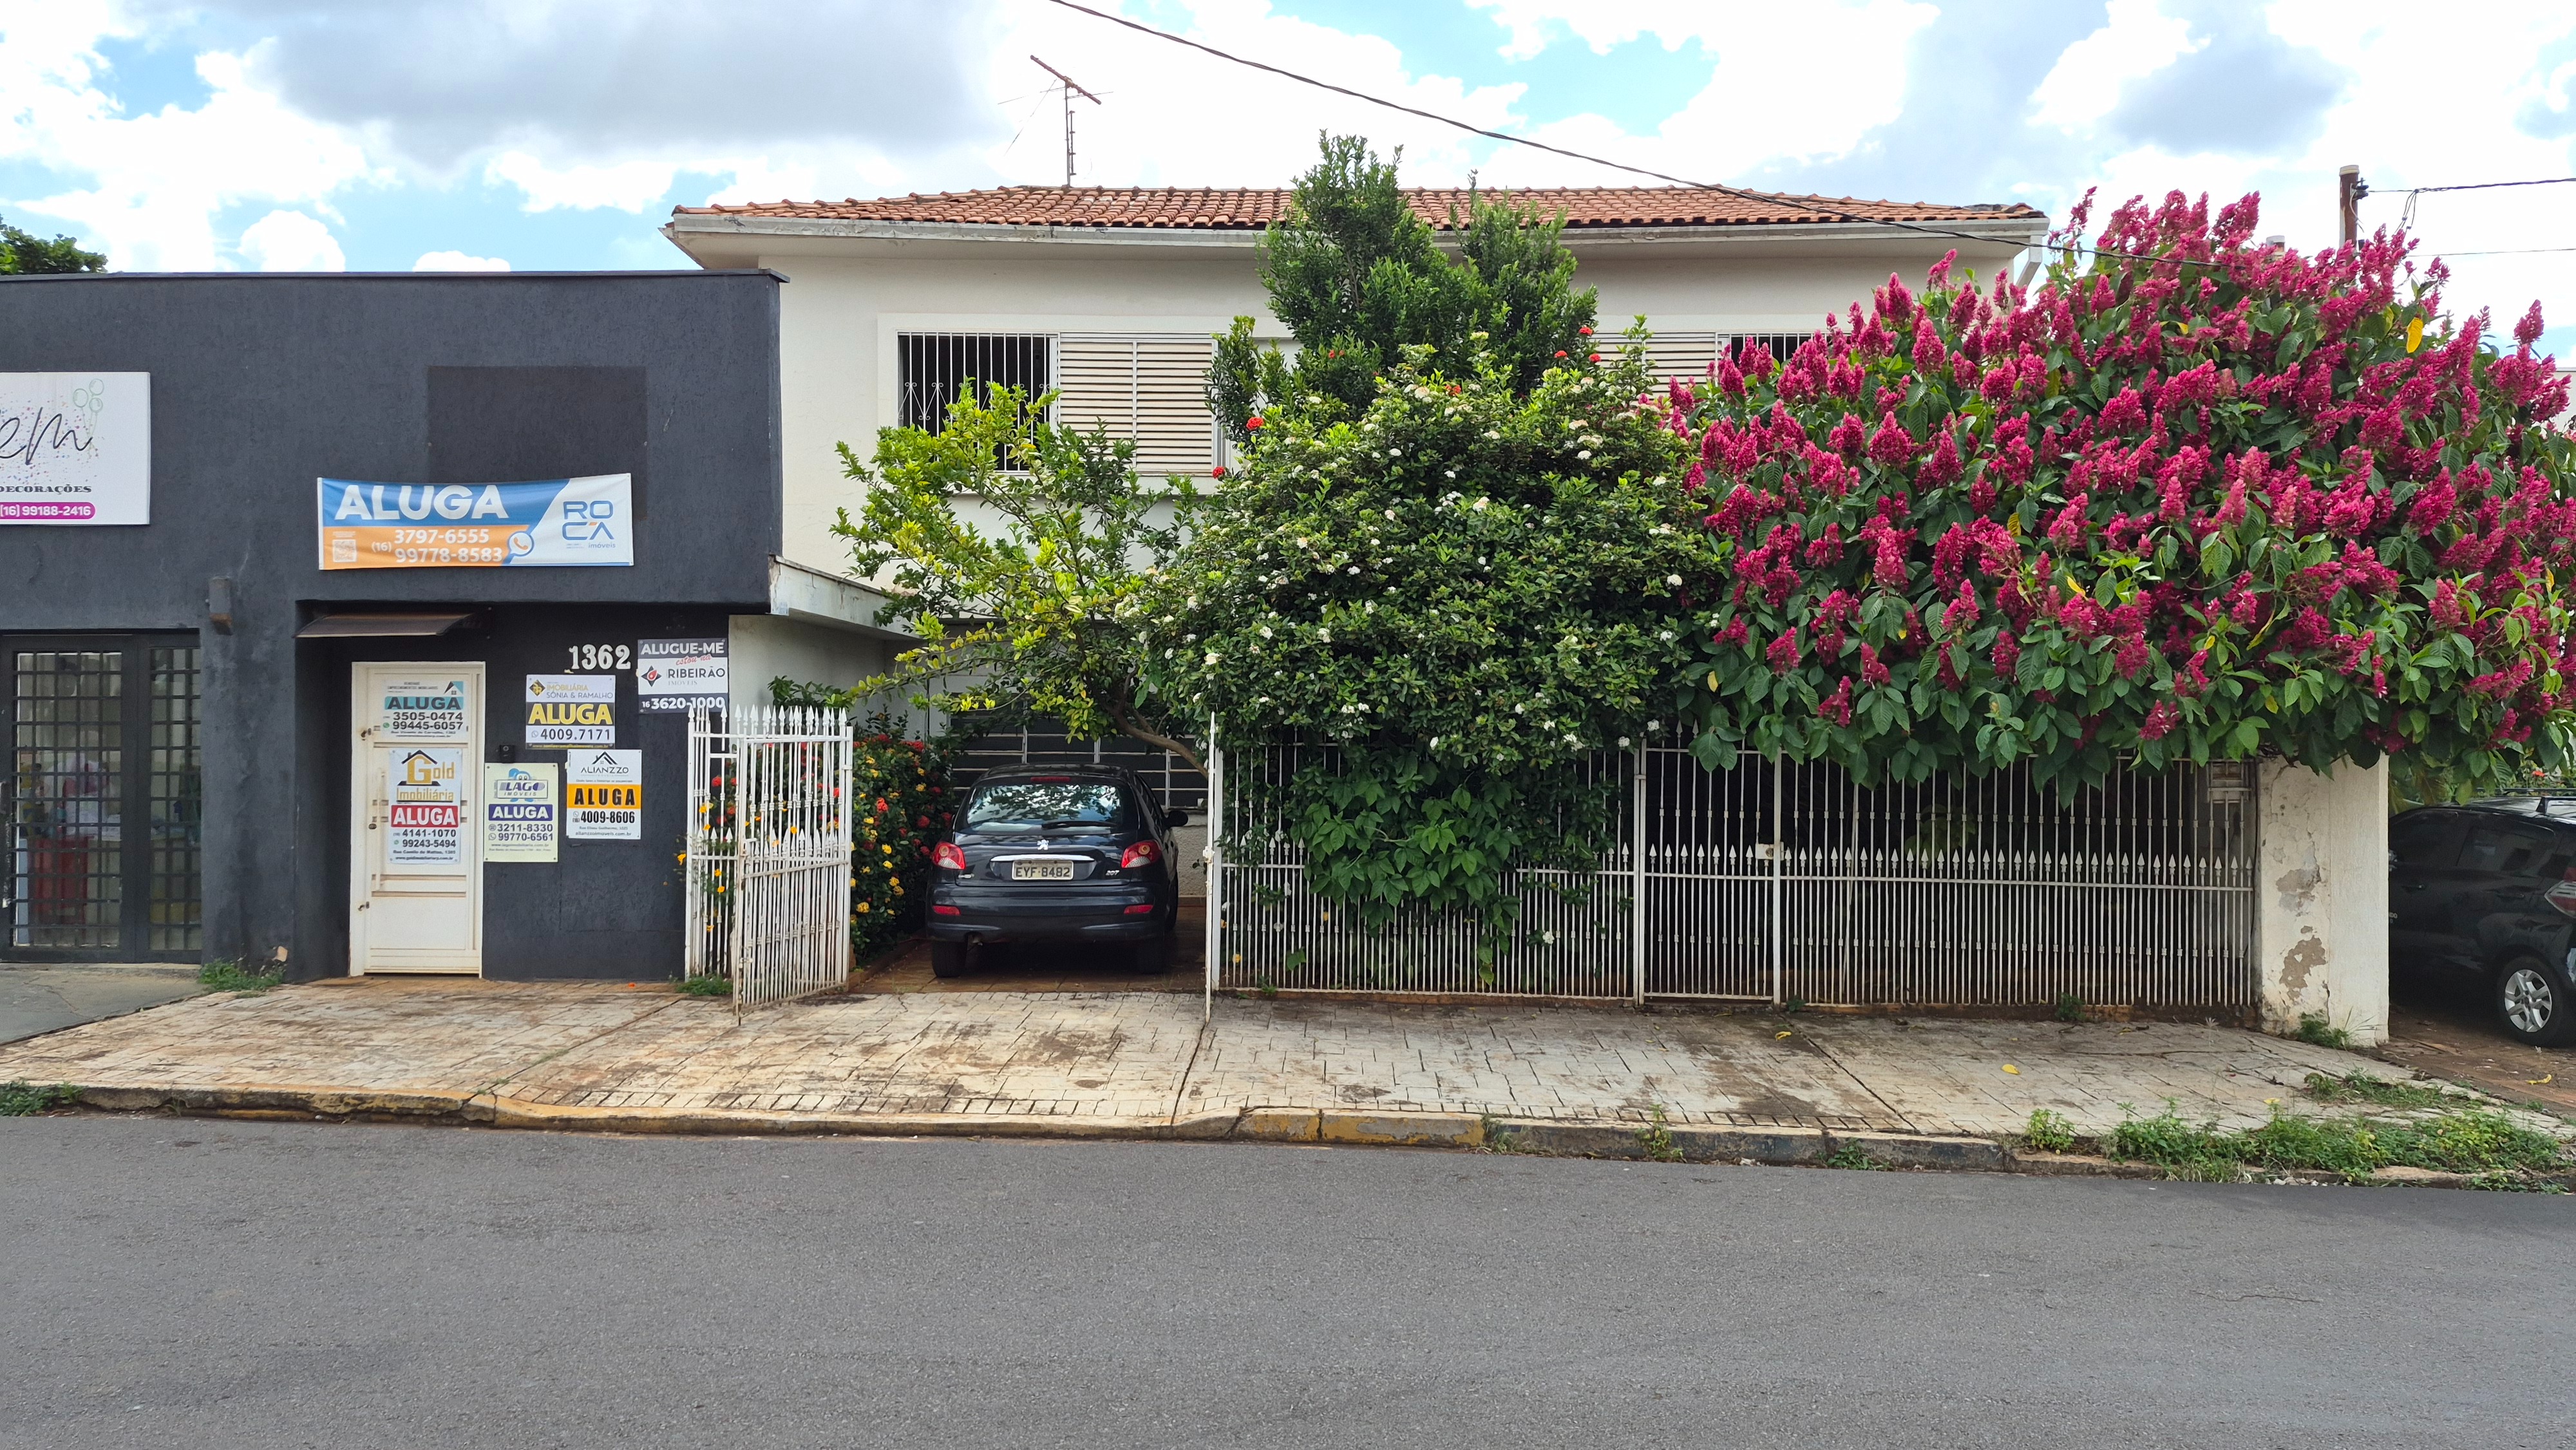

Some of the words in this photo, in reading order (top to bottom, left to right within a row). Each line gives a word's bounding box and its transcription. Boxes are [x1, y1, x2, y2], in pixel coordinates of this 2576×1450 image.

[334, 485, 509, 520] ALUGA
[22, 505, 91, 516] 99188-2416
[394, 529, 489, 544] 3797-6555
[371, 541, 392, 552] (16)
[395, 547, 503, 563] 99778-8583
[641, 643, 725, 655] ALUGUE-ME
[569, 644, 631, 670] 1362
[676, 655, 697, 666] estou
[700, 654, 712, 662] na
[668, 666, 726, 679] RIBEIRÃO
[387, 697, 462, 710] ALUGA
[651, 697, 725, 709] 3620-1000
[393, 712, 463, 720] 3505-0474
[528, 703, 613, 725] ALUGA
[393, 721, 463, 730] 99445-6057
[540, 728, 610, 740] 4009.7171
[407, 754, 455, 784] Gold
[397, 787, 453, 800] Imobiliária
[574, 787, 635, 805] ALUGA
[393, 807, 456, 825] ALUGA
[492, 806, 549, 819] ALUGA
[581, 811, 635, 824] 4009-8606
[497, 824, 553, 832] 3211-8330
